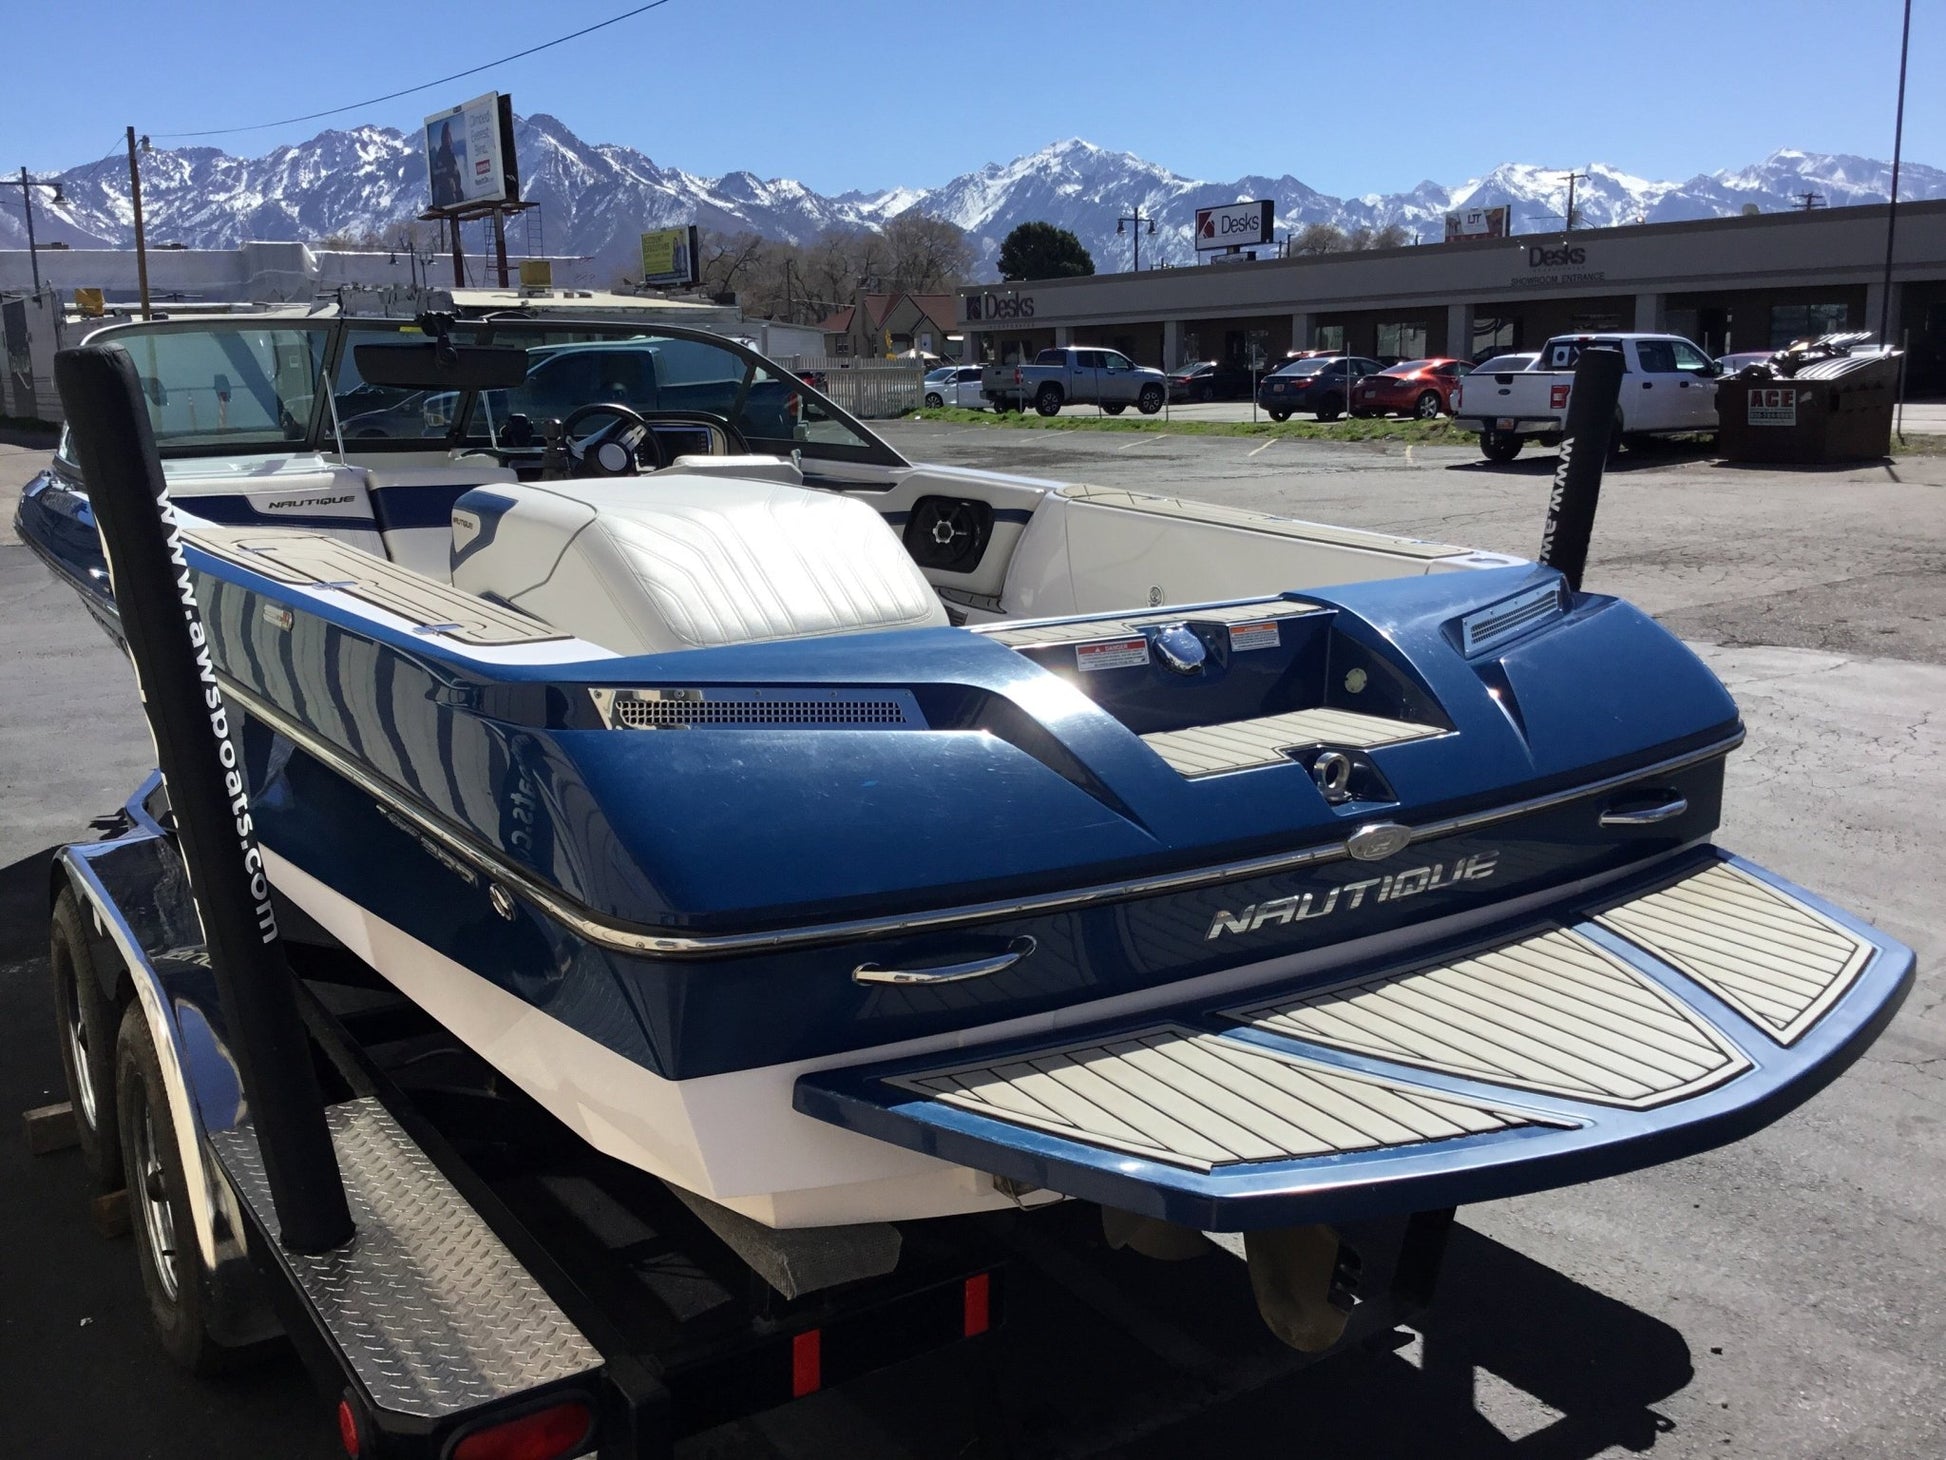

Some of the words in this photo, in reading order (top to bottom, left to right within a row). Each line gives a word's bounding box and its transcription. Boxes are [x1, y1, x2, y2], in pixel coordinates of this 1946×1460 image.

[1221, 212, 1259, 234] Desks
[1529, 244, 1586, 267] Desks
[1511, 275, 1558, 287] SHOWROOM
[1561, 271, 1605, 282] ENTRANCE
[985, 292, 1034, 319] Desks
[1751, 390, 1794, 407] ACE
[268, 495, 356, 509] NAUTIQUE
[1540, 437, 1575, 566] www.aw
[157, 486, 278, 944] www.awsboats.com
[1204, 850, 1499, 942] NAUTIQUE
